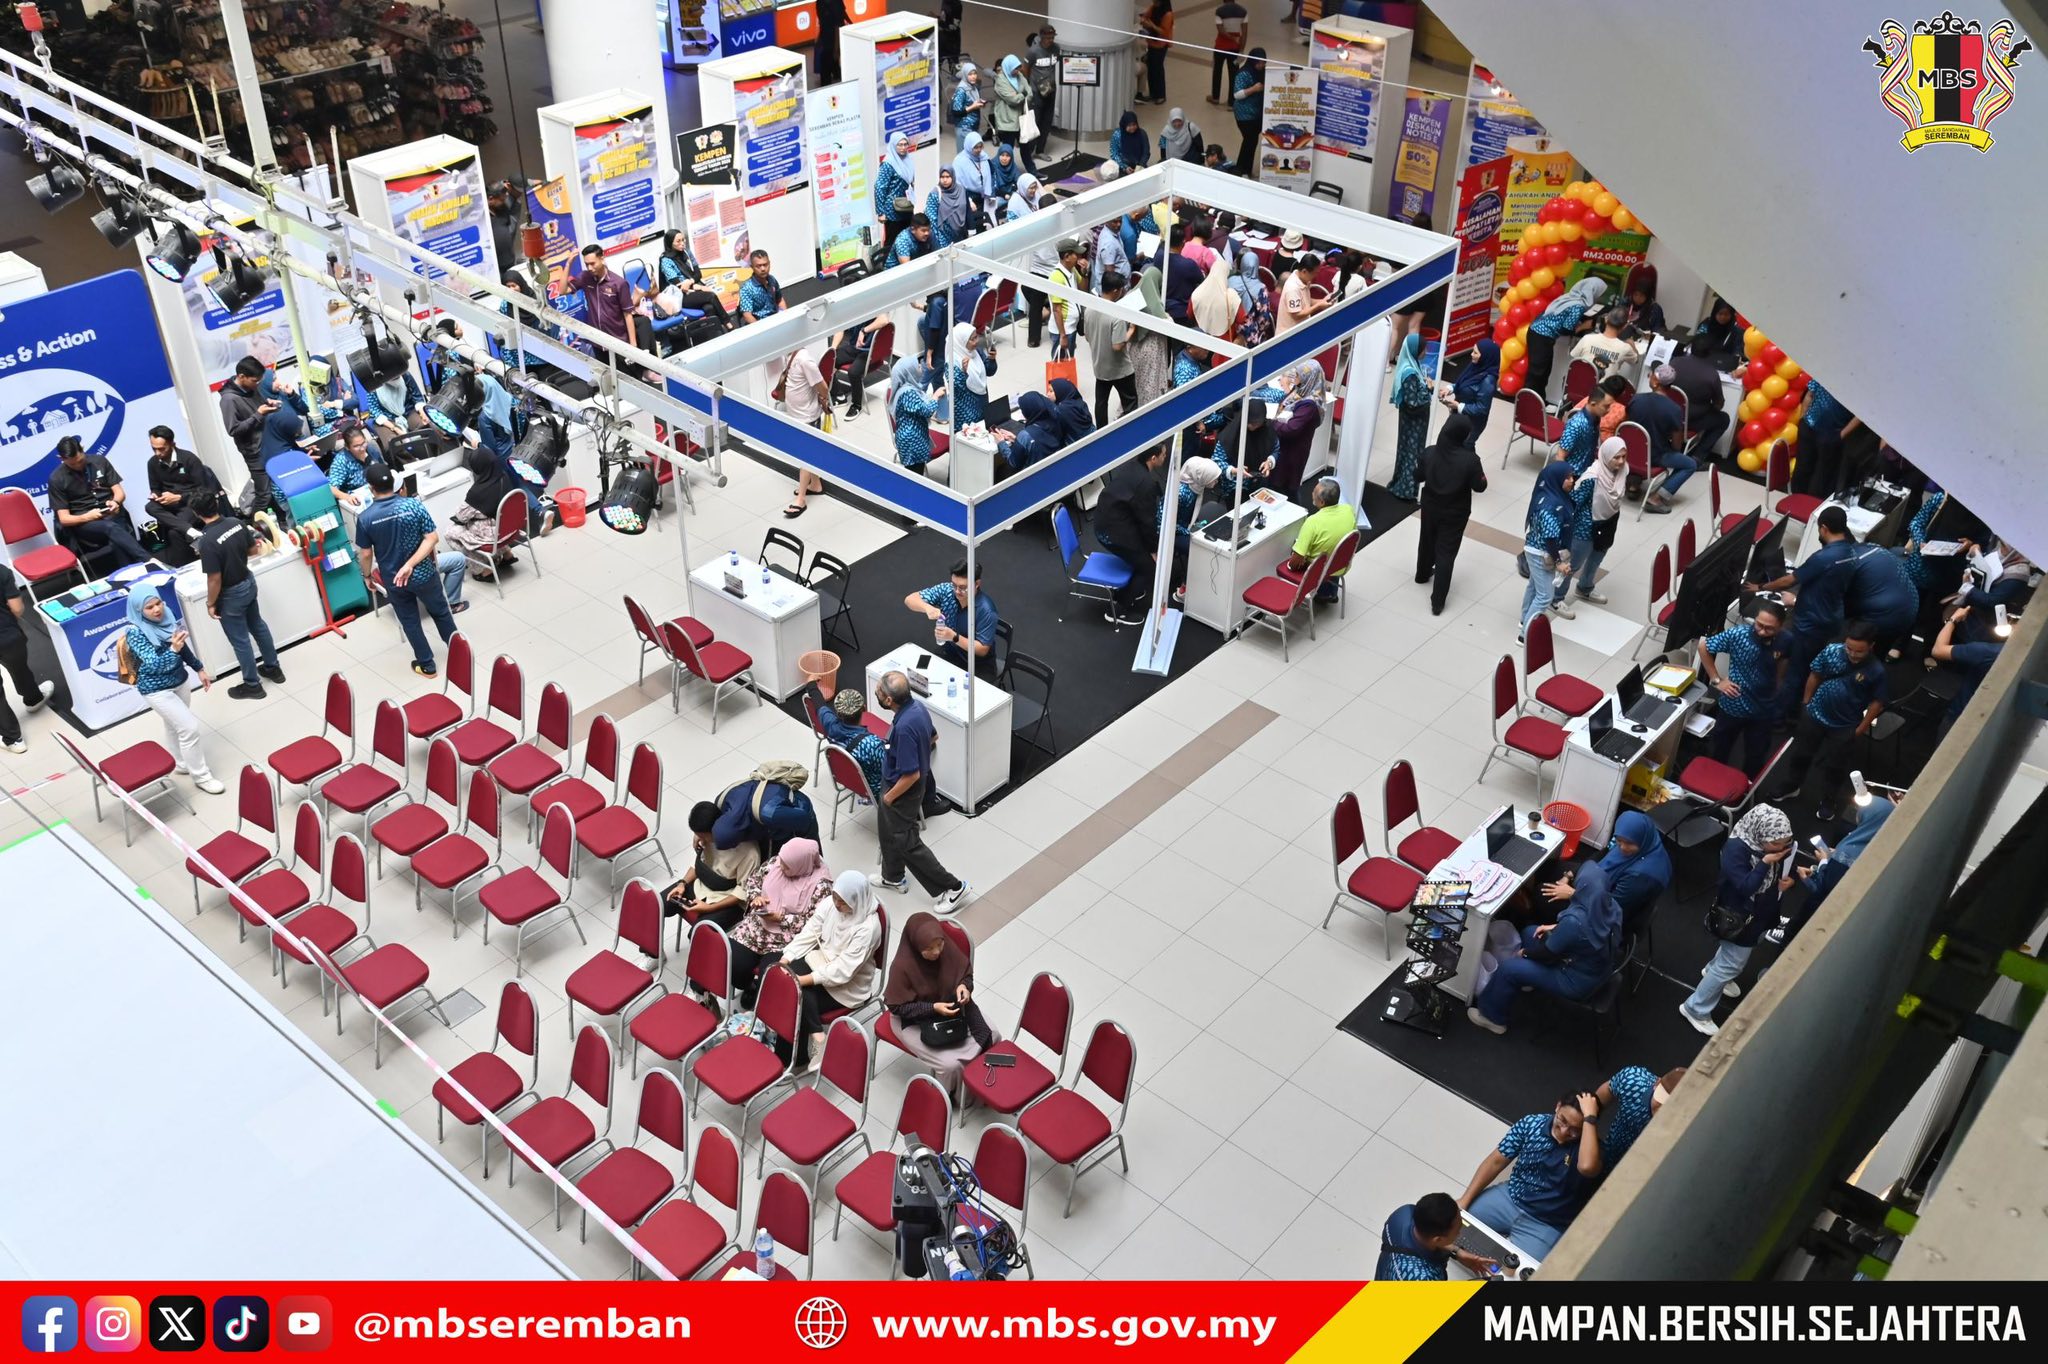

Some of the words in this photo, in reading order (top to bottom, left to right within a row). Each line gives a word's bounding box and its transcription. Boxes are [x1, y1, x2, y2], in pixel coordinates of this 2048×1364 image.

[731, 28, 767, 47] vivo
[1406, 120, 1442, 137] DISKAUN
[1408, 113, 1442, 128] KEMPEN
[1406, 128, 1432, 141] NOTIS
[694, 146, 727, 164] KEMPEN
[1406, 150, 1431, 166] 50%
[1462, 206, 1502, 228] KESALAHAN
[1583, 250, 1637, 263] RM2,000.00
[547, 282, 560, 300] 2
[555, 295, 568, 312] 3
[1289, 299, 1301, 309] 82
[18, 346, 32, 363] &
[37, 328, 97, 358] Action
